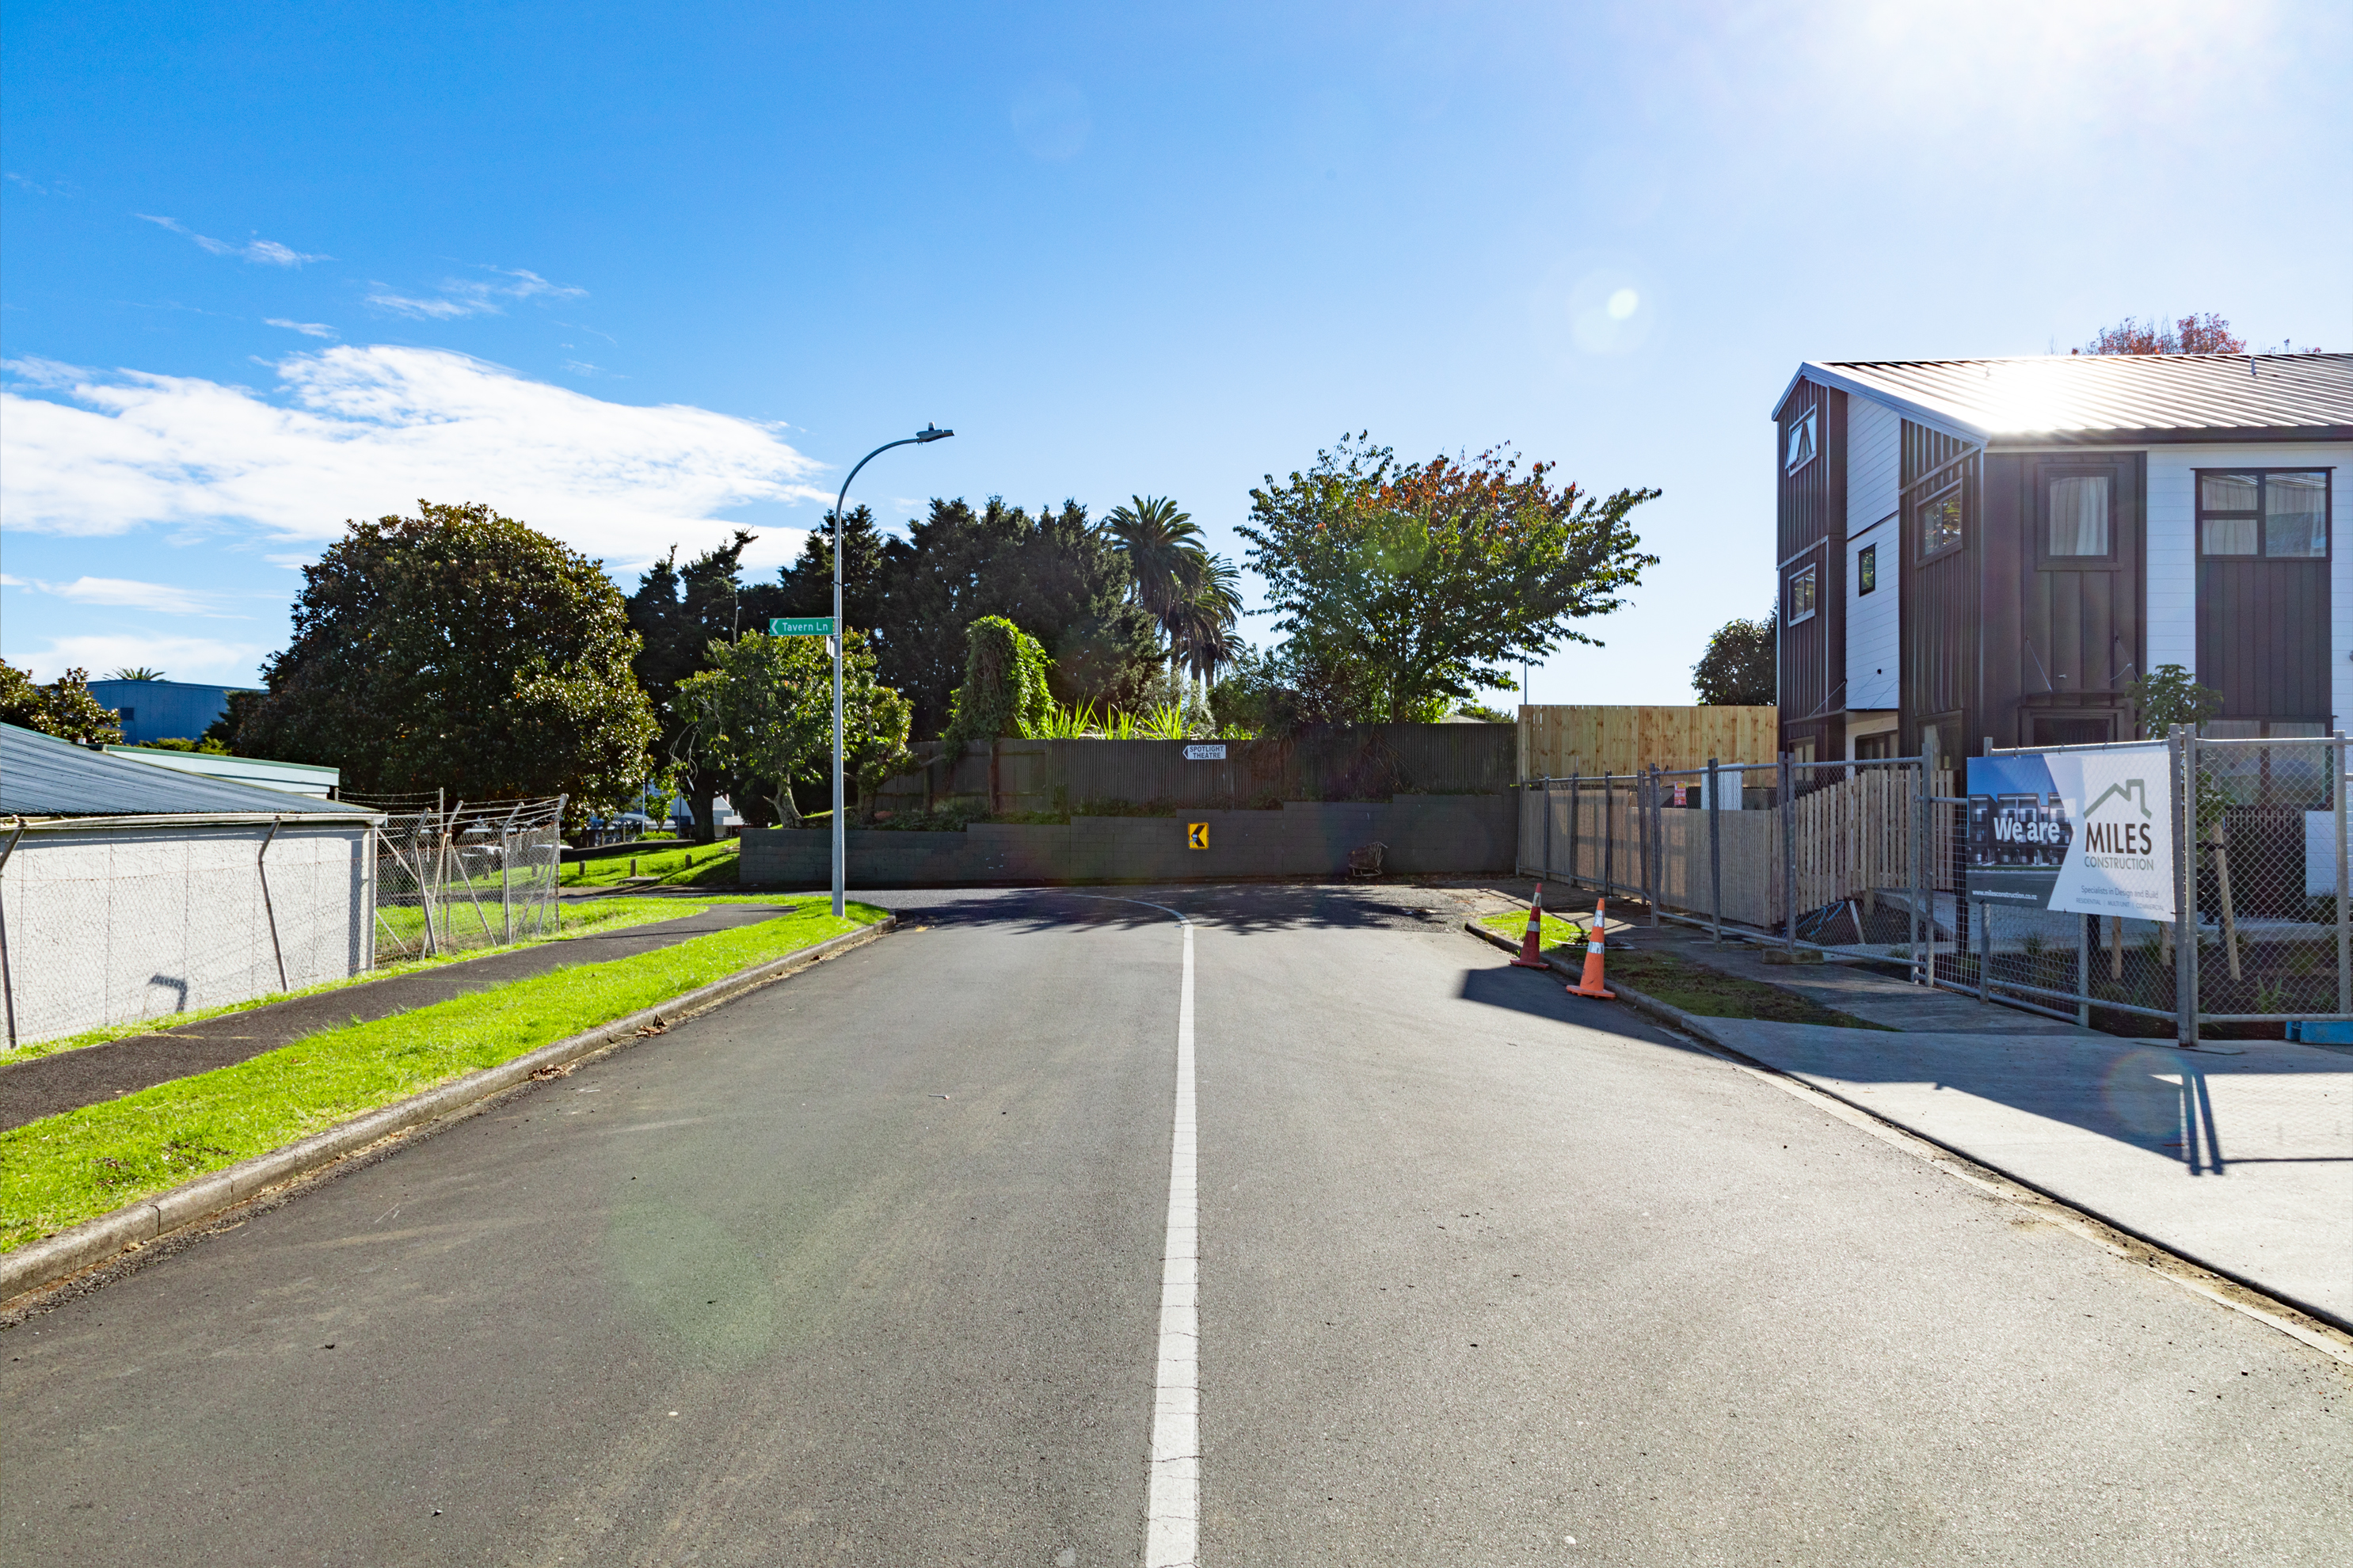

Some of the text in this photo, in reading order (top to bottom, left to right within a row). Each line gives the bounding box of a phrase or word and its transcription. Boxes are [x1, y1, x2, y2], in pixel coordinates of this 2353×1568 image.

[782, 622, 828, 632] Tavern Ln
[1993, 817, 2060, 842] We are
[2085, 822, 2152, 855] MILES
[2084, 856, 2154, 871] CONSTRUCTION
[1972, 889, 2038, 900] www.milesconstruction.co.nz
[2081, 885, 2108, 895] Specialists
[2115, 888, 2134, 898] Design
[2145, 890, 2159, 899] Build
[2076, 897, 2101, 906] RESIDENTIAL
[2135, 903, 2165, 911] COMMERCIAL
